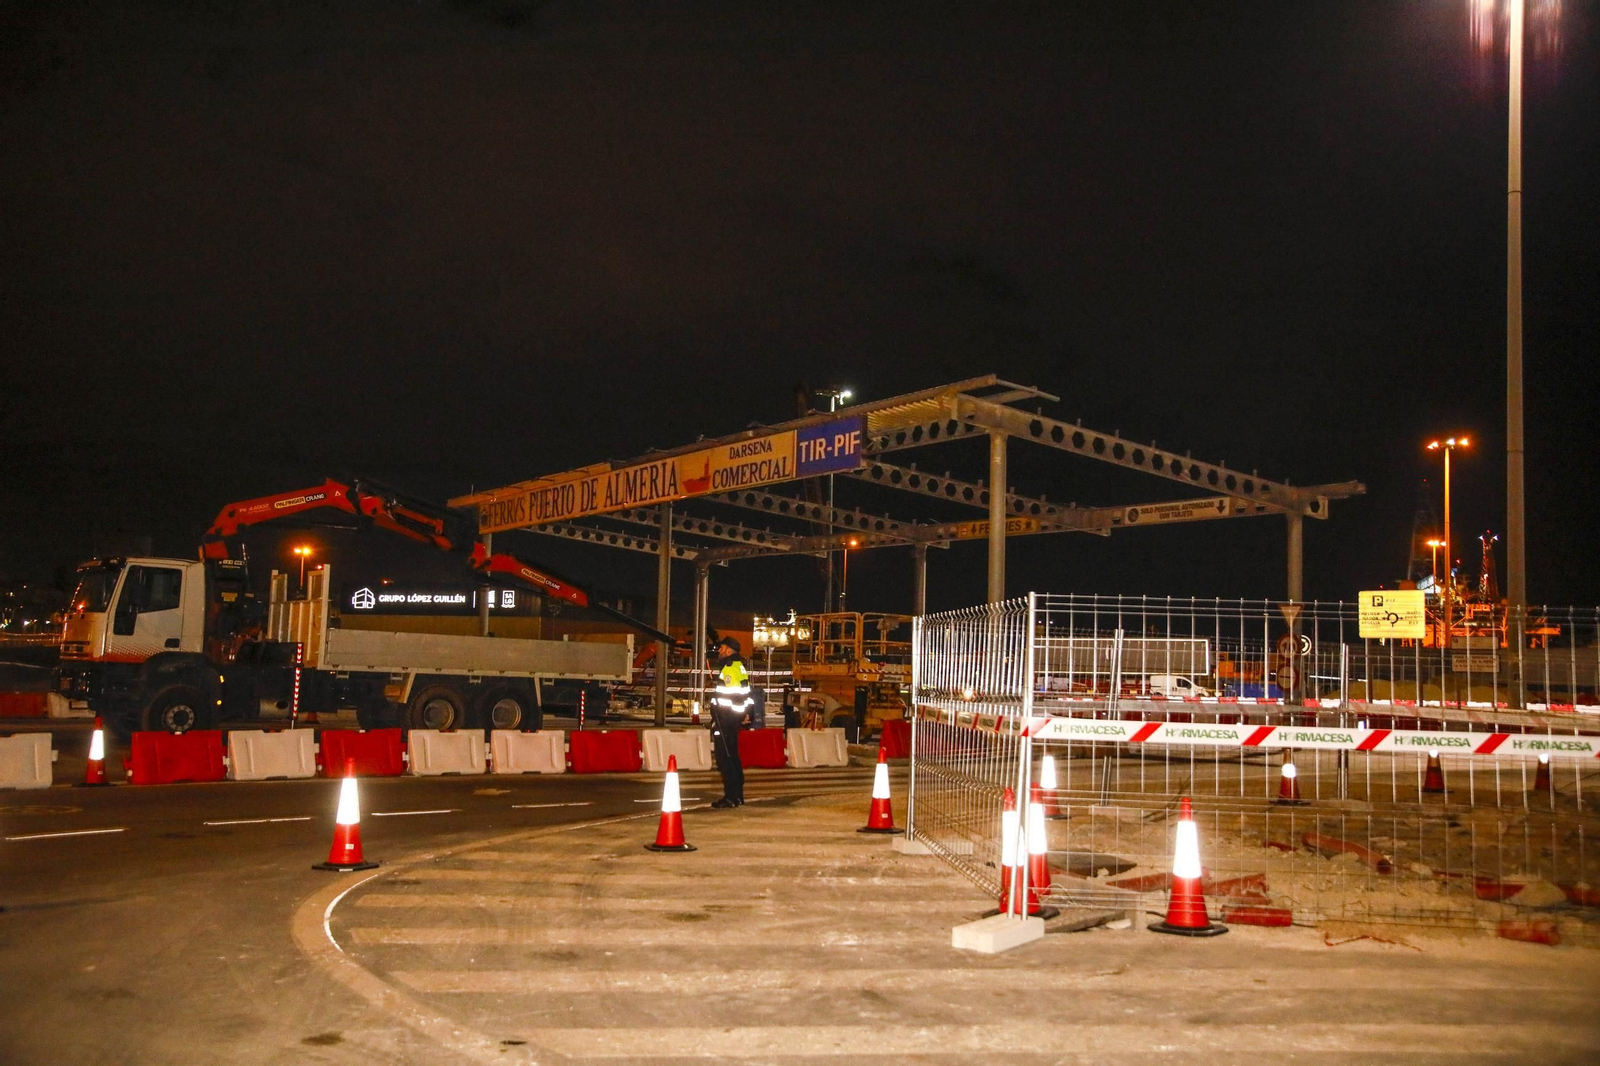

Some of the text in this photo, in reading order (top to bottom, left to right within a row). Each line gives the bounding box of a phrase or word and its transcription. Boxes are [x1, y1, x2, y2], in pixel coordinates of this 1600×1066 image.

[729, 439, 772, 460] DARSENA
[799, 430, 861, 463] TIR-PIF
[712, 456, 791, 490] COMERCIAL
[305, 493, 325, 502] CRANE
[529, 484, 575, 522] PUERTO
[580, 477, 599, 513] DE
[603, 460, 679, 508] ALMERIA
[1140, 501, 1215, 515] SOLO PERSONAL AUTORIZADO
[1171, 510, 1193, 518] TARJETA
[978, 520, 1022, 535] FEIES
[379, 593, 466, 603] GRUPO LÓPEZ GUILLÉN
